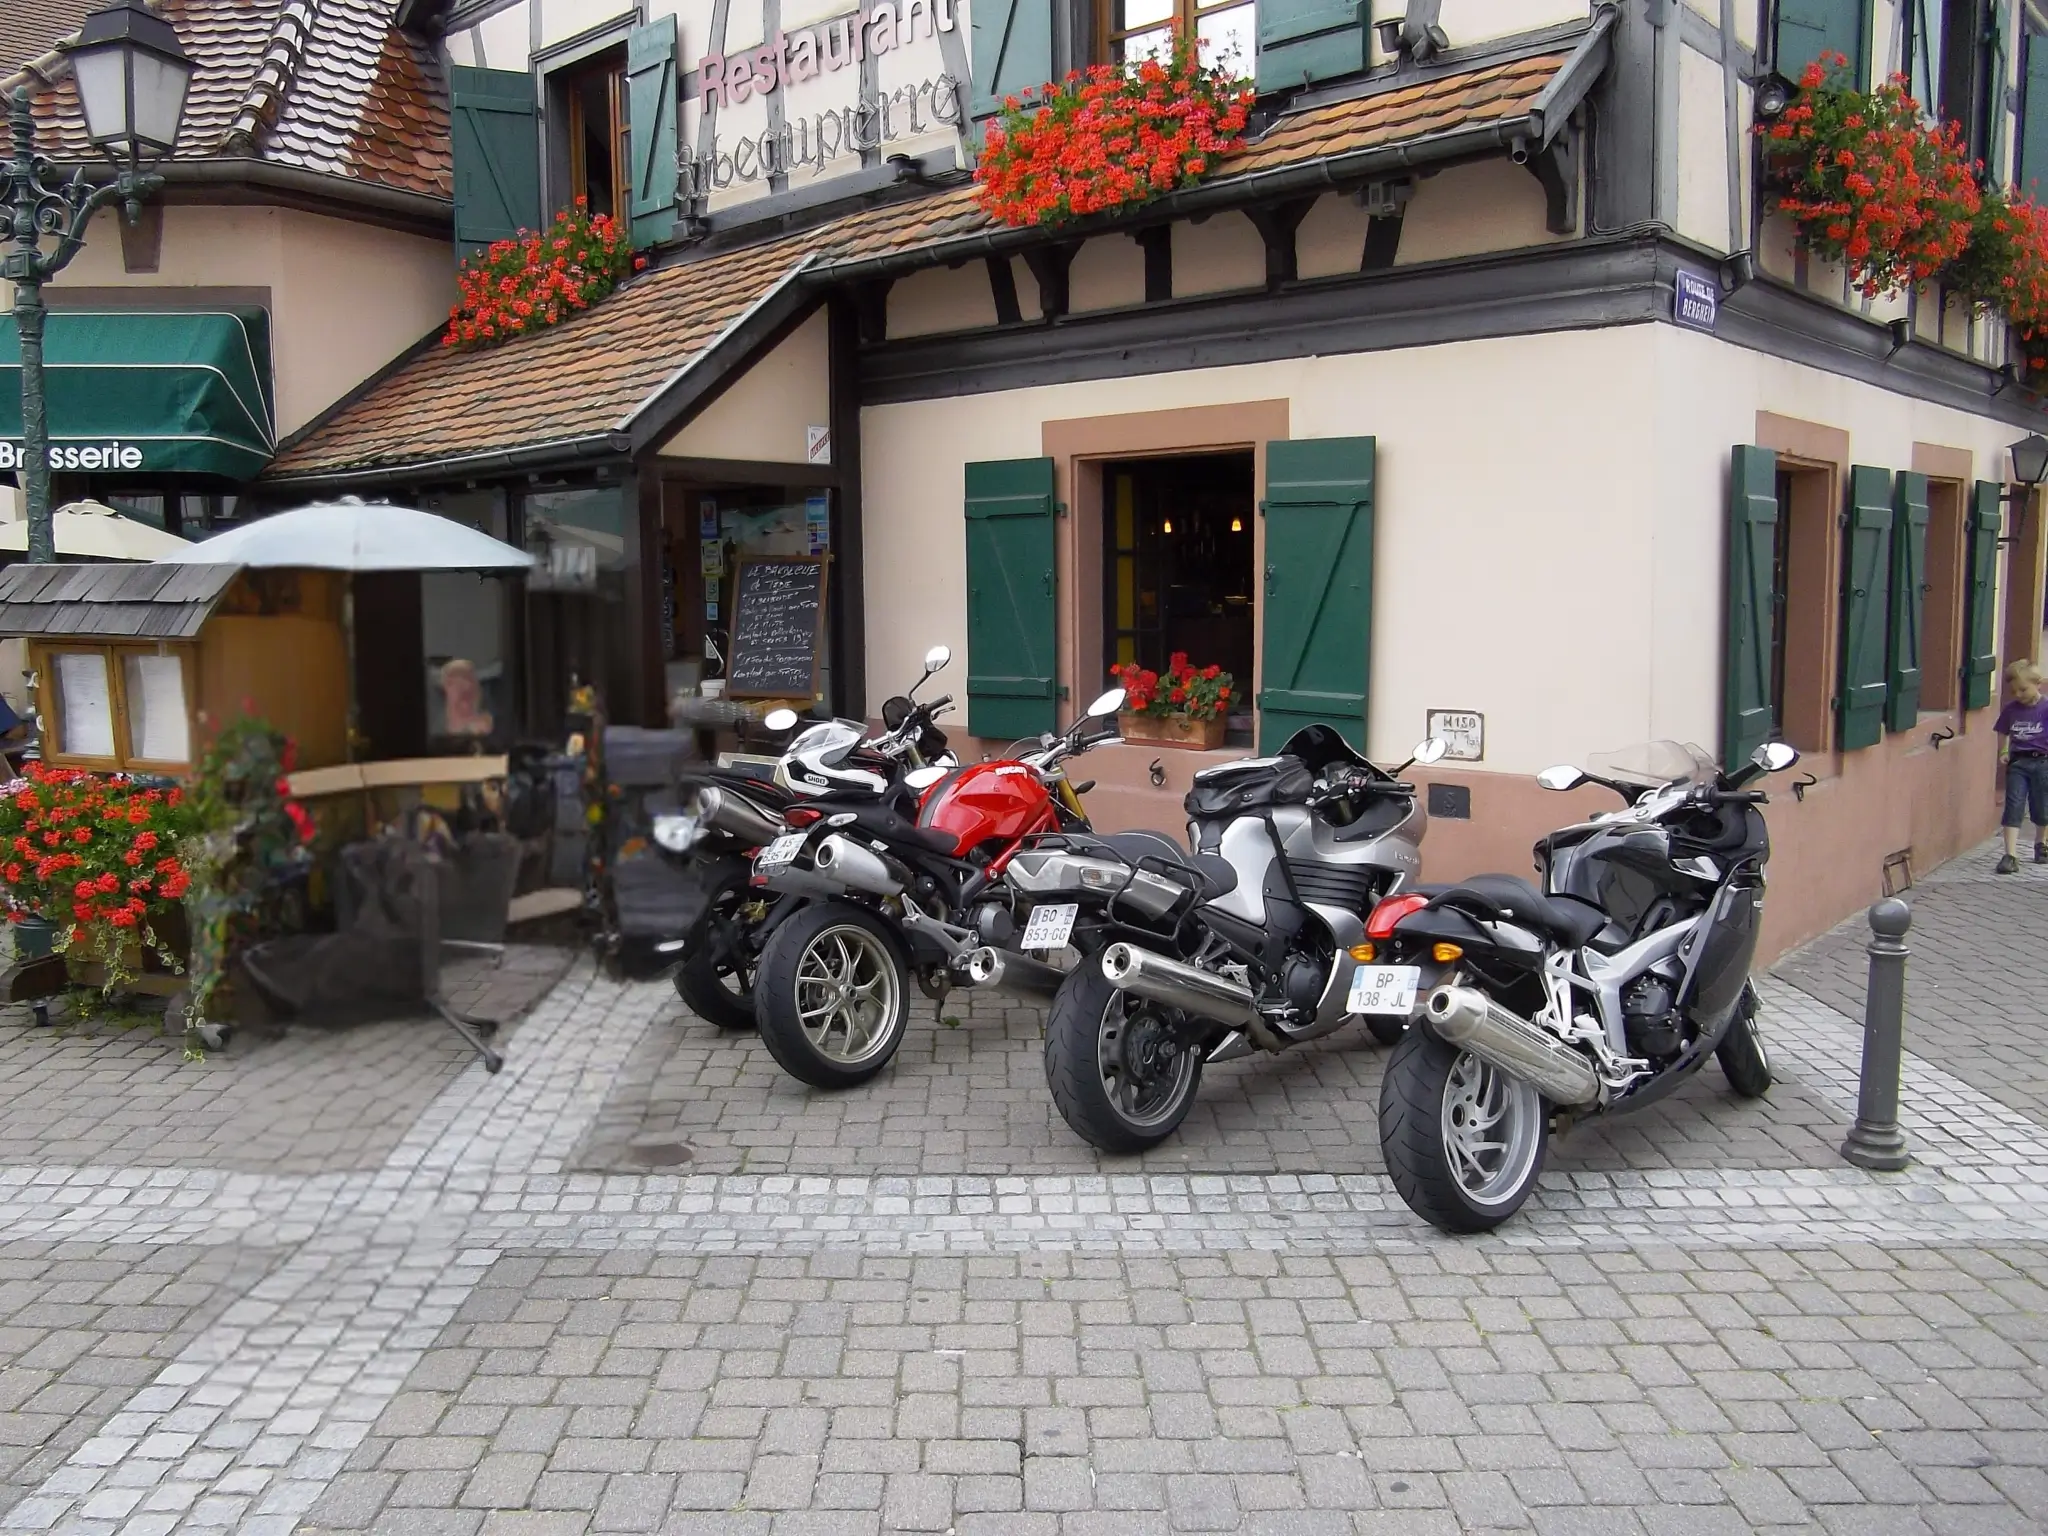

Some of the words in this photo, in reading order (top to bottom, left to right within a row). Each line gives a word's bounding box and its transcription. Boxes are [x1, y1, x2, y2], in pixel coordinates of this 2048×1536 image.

[1685, 278, 1706, 298] ROUTE
[0, 441, 143, 469] Brsserie
[807, 775, 826, 785] SHOEI
